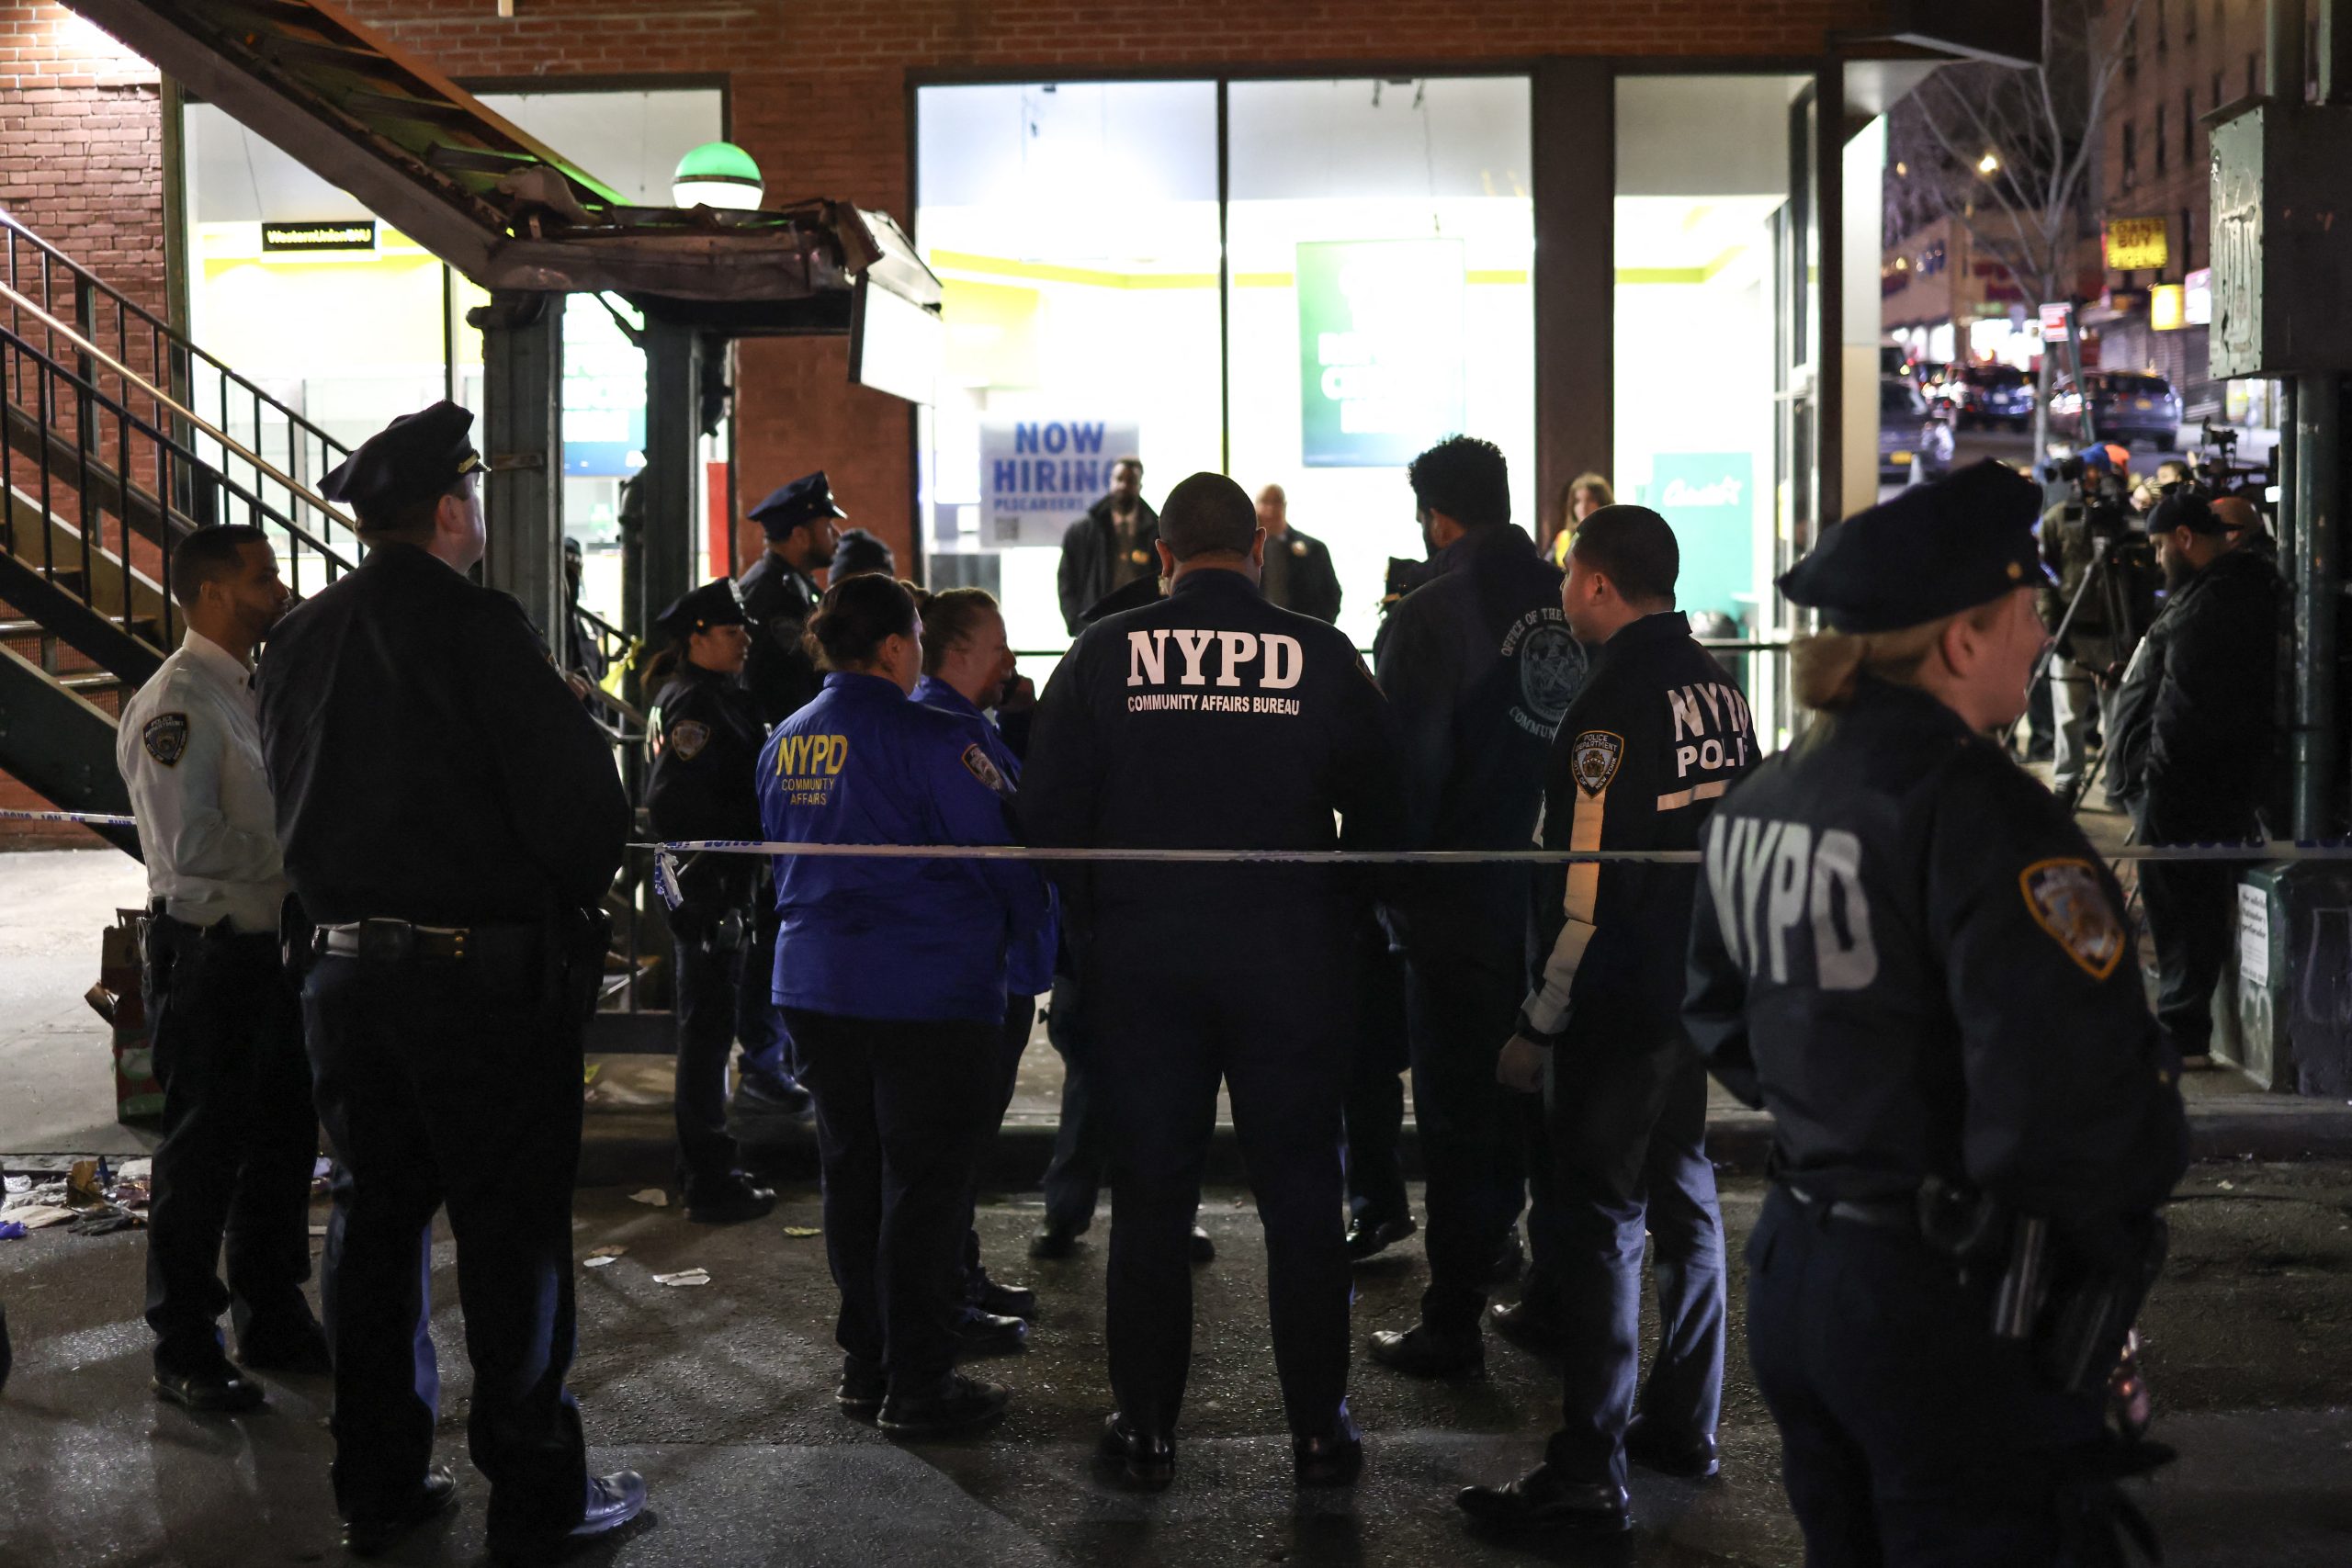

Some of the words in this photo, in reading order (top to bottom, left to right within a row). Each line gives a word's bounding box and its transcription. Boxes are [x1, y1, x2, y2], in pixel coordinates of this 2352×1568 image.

[1015, 422, 1104, 455] NOW
[1500, 619, 1526, 658] OFFICE
[1524, 610, 1538, 626] OF
[1540, 607, 1563, 622] THE
[1126, 629, 1303, 689] NYPD
[1127, 694, 1198, 712] COMMUNITY
[1201, 695, 1250, 713] AFFAIRS
[1253, 696, 1300, 716] BUREAU
[1668, 682, 1750, 741] NYPD
[1574, 739, 1618, 752] DEPARTMENT
[1583, 734, 1609, 742] POLICE
[776, 734, 848, 776] NYPD
[782, 778, 835, 791] COMMUNITY
[790, 793, 828, 807] AFFAIRS
[1706, 814, 1878, 990] NYPD
